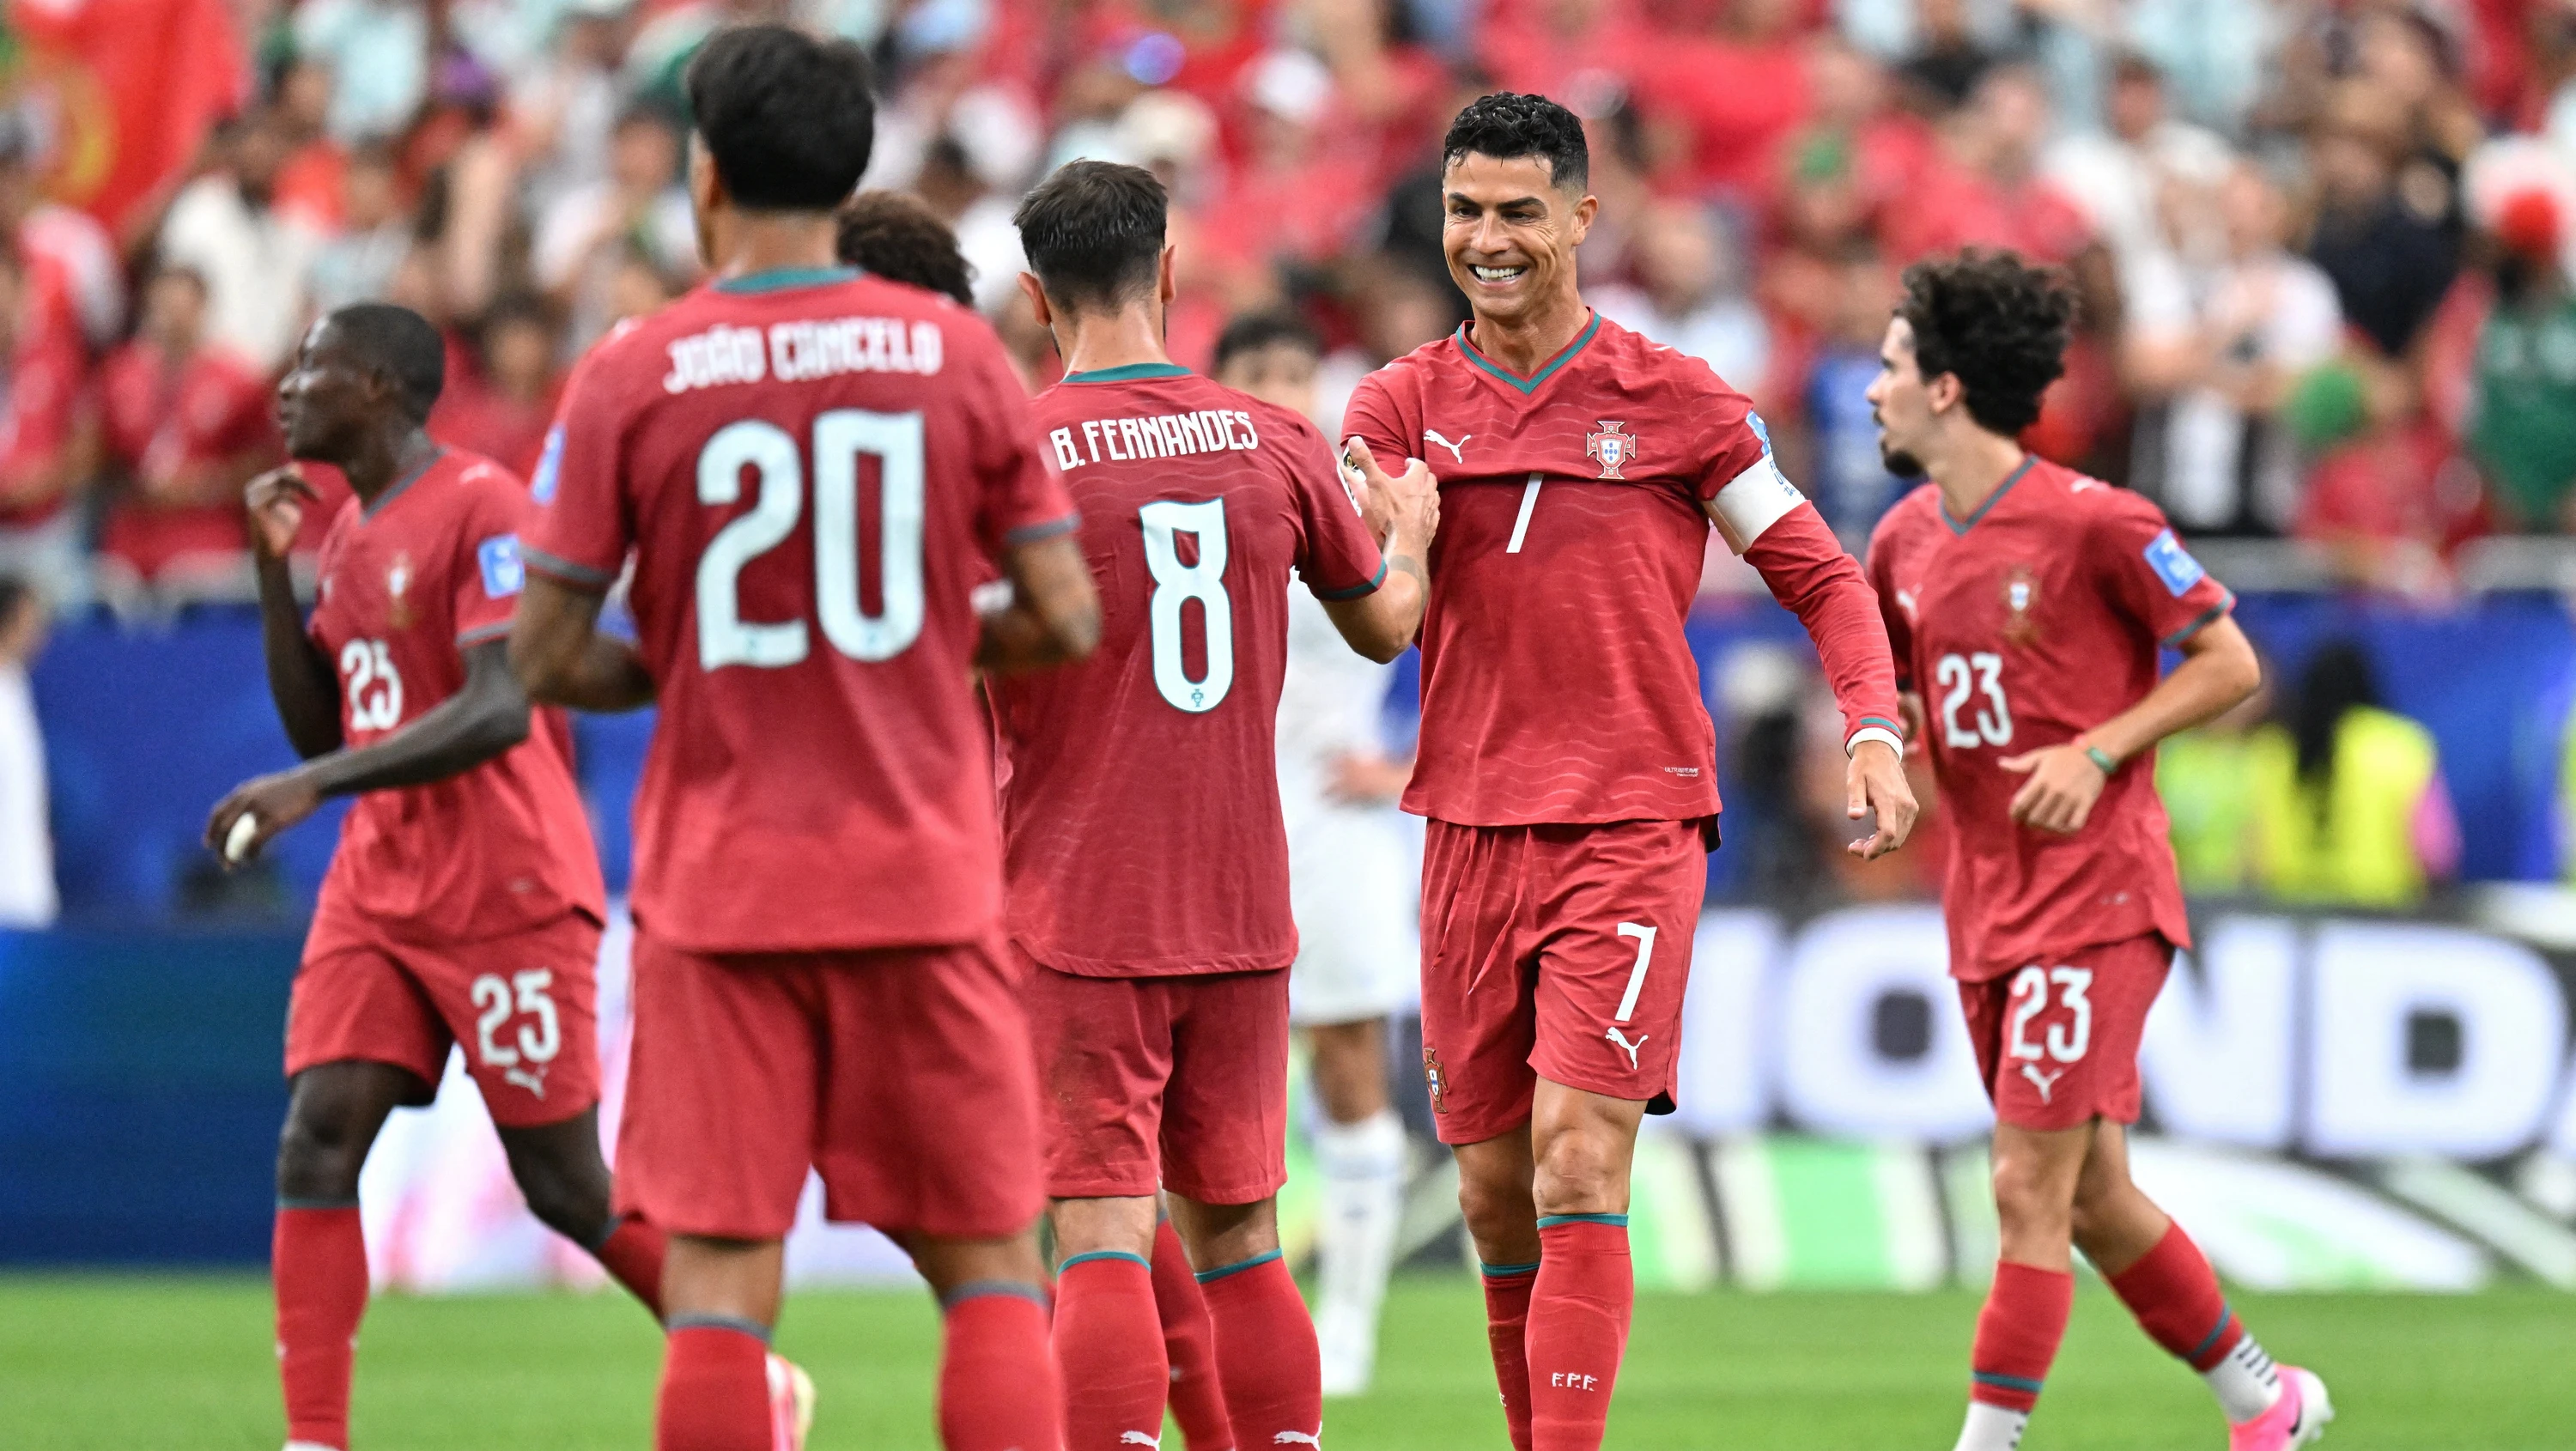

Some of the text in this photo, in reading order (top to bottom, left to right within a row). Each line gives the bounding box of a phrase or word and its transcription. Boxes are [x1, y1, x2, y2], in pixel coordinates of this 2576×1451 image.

[663, 316, 945, 394] JOÃO CANCELO
[1049, 410, 1259, 471] B. FERNANDES
[696, 408, 925, 671] 20
[1139, 496, 1234, 713] 8
[1936, 653, 2013, 749] 23
[471, 968, 561, 1066] 25
[1615, 921, 1658, 1022] 7
[2008, 965, 2093, 1063] 23
[1670, 906, 2576, 1159] OND
